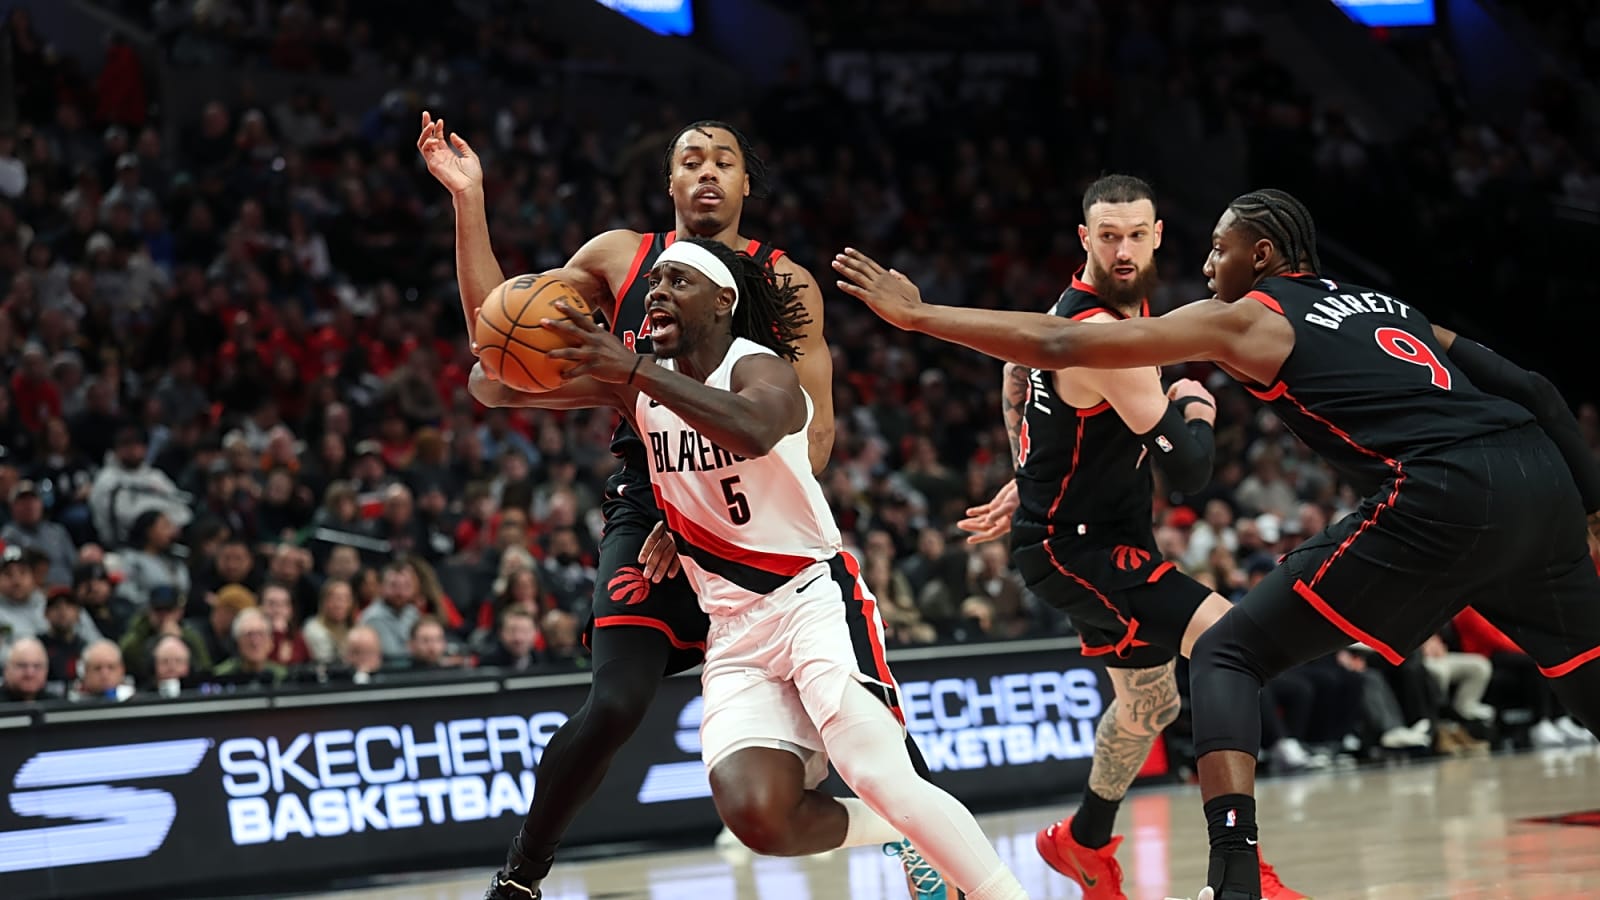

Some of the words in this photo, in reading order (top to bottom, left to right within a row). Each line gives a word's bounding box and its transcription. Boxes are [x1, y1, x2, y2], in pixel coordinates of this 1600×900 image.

[1305, 292, 1410, 330] BARRETT
[1375, 327, 1451, 390] 9
[648, 429, 748, 473] BLAER
[719, 474, 752, 526] 5
[901, 668, 1102, 733] ECHERS
[910, 719, 1096, 772] KETBALL
[227, 769, 536, 846] BASKETBA
